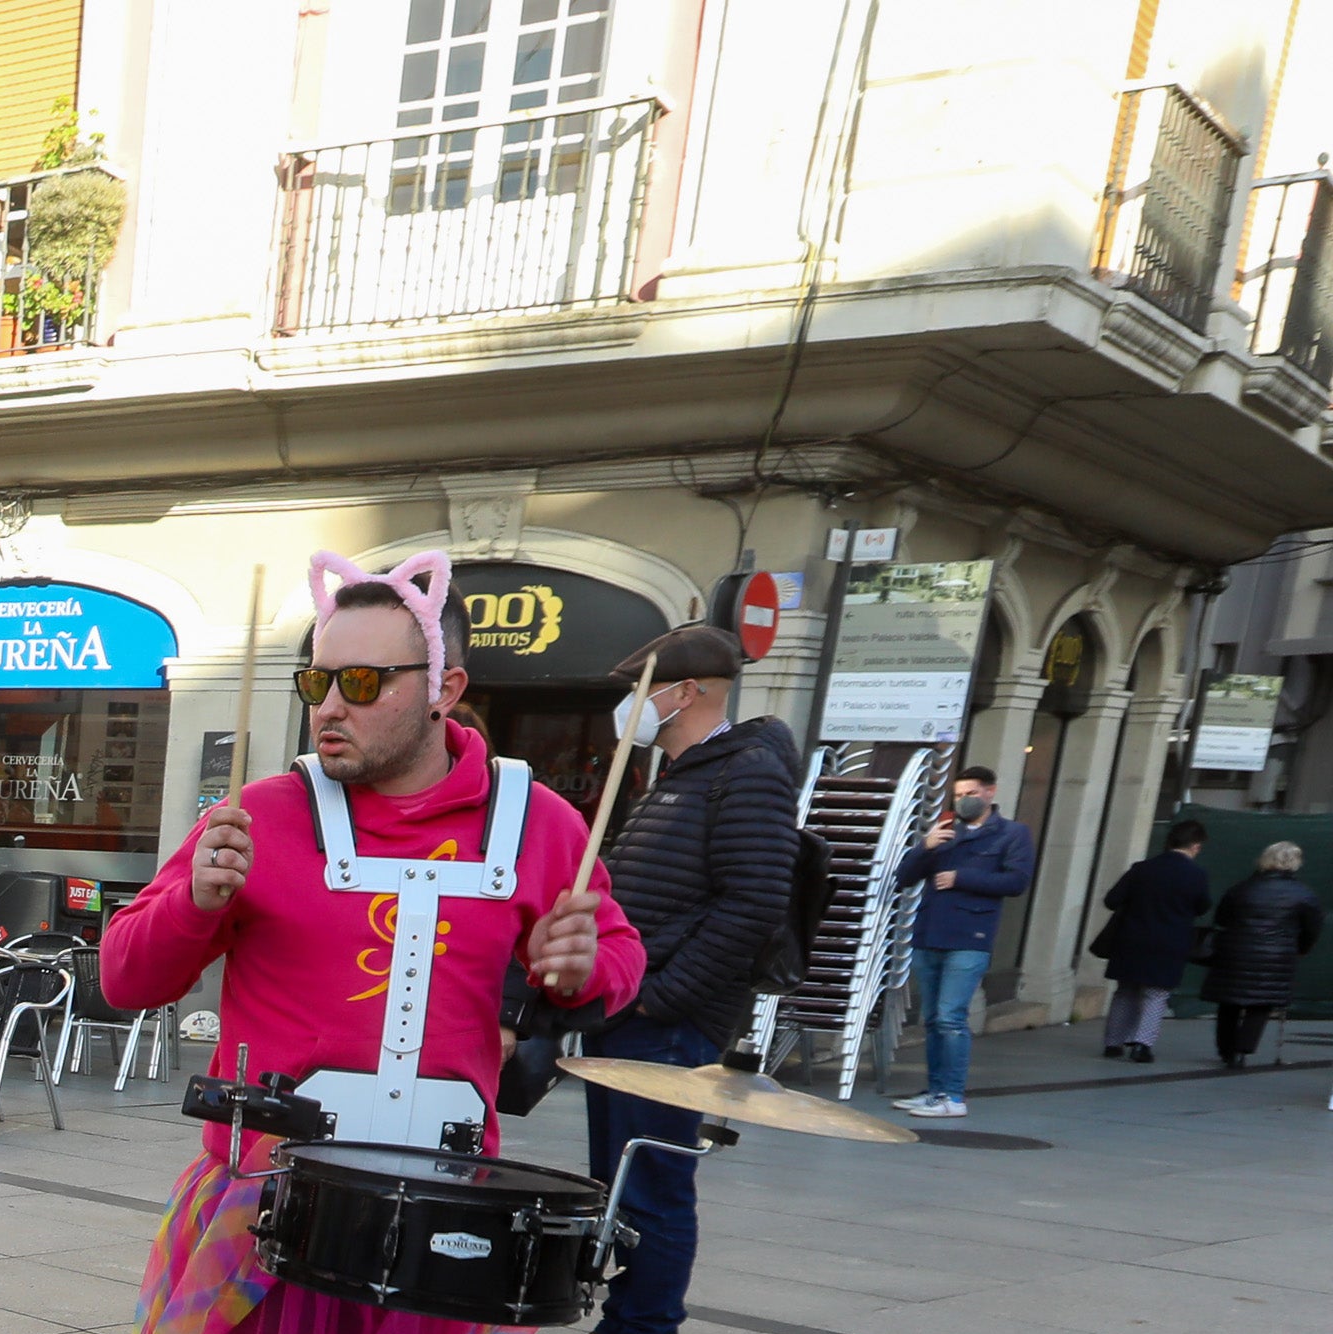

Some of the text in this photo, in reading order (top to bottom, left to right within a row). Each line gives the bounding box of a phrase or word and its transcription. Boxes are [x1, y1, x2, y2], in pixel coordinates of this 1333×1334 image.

[895, 608, 979, 619] ruta monumental
[23, 621, 42, 636] LA
[841, 634, 868, 643] teatro
[870, 632, 905, 642] Palacio
[863, 656, 894, 667] palacio
[896, 656, 908, 665] de
[842, 700, 877, 710] Palacio
[826, 723, 899, 734] Centro Niemeyer
[2, 753, 65, 766] CERVECERÍA
[26, 768, 39, 778] LA
[69, 886, 99, 899] JUST EAT
